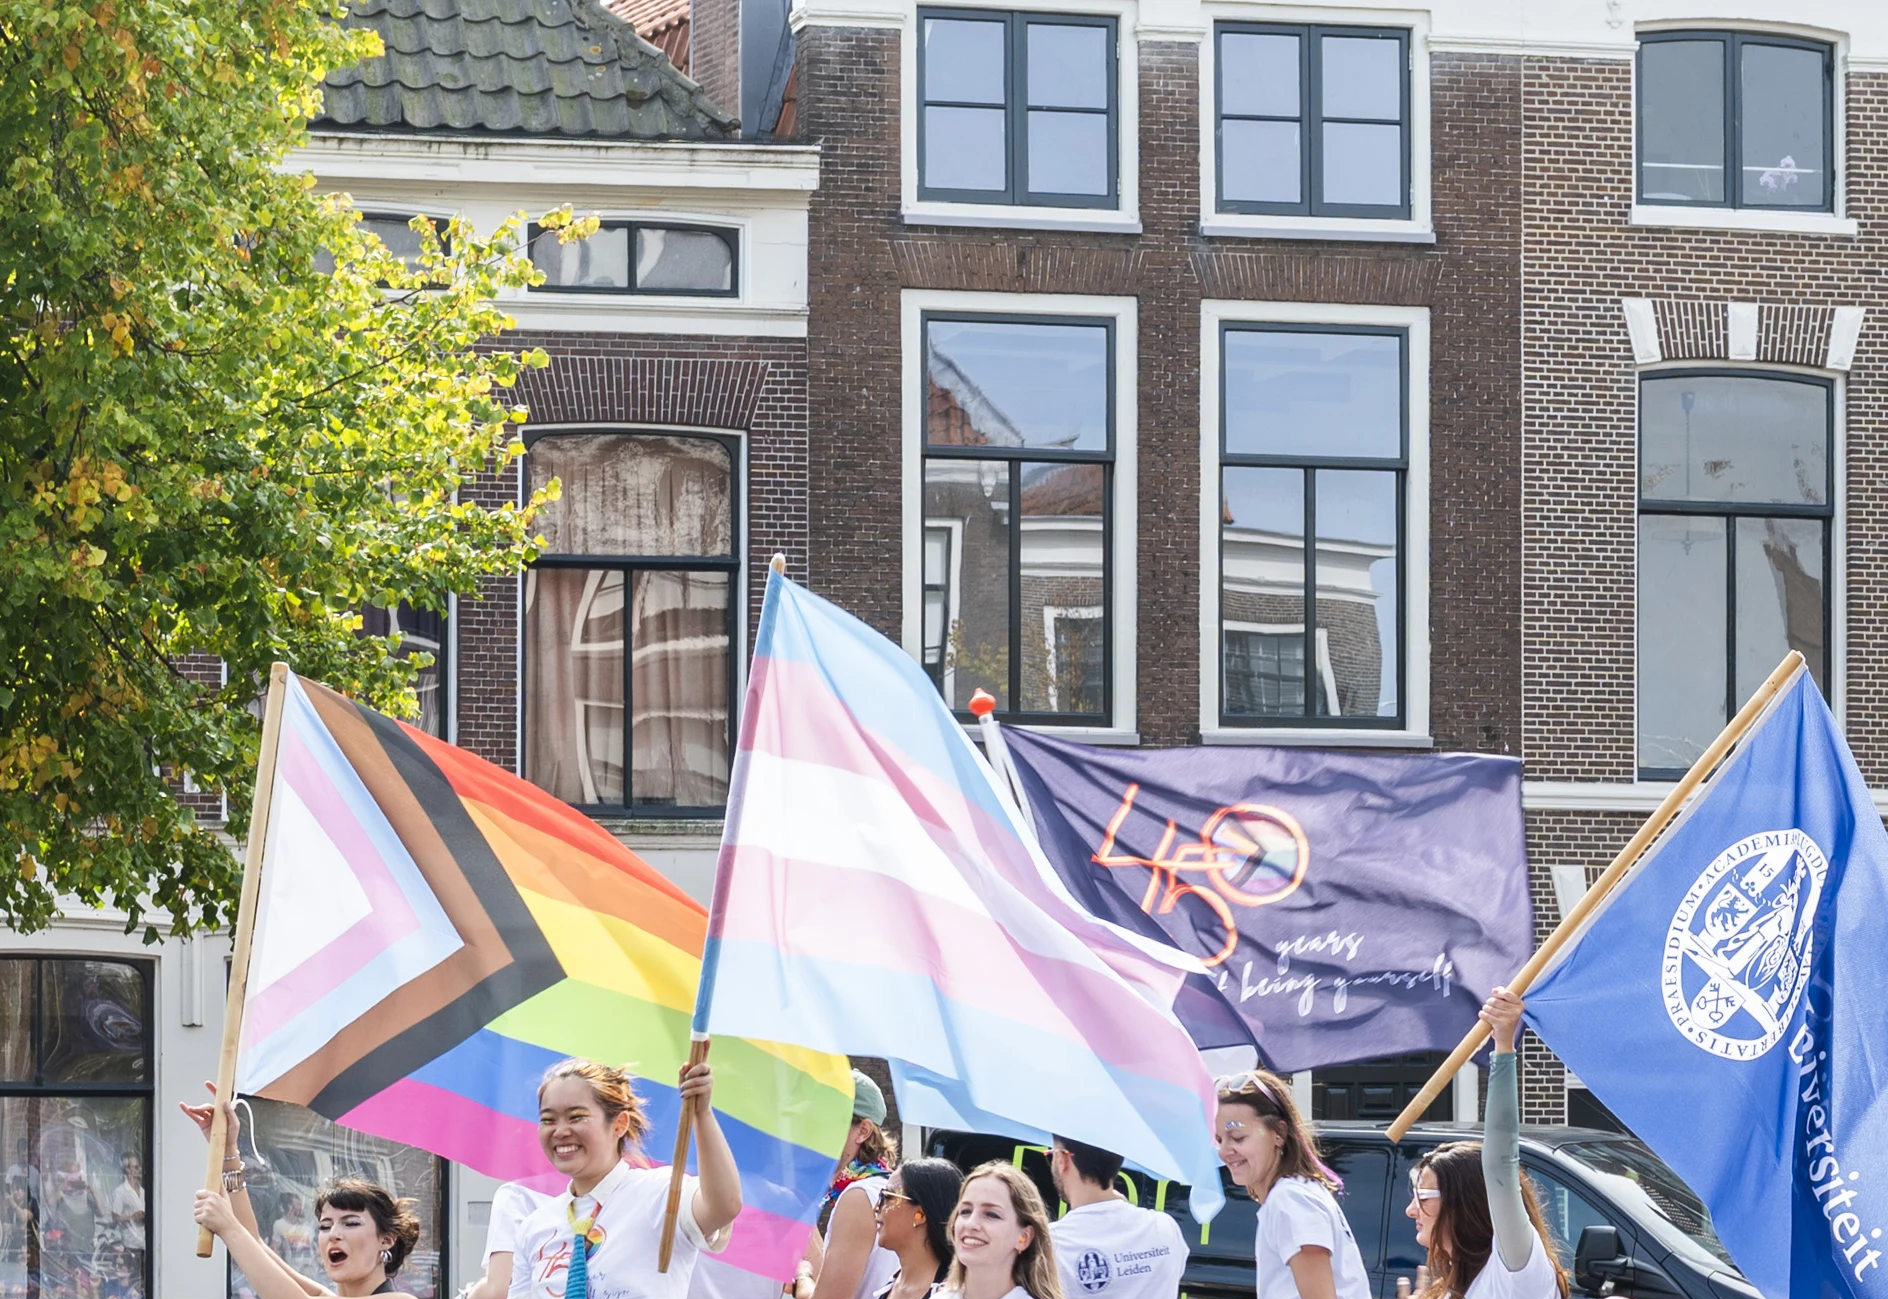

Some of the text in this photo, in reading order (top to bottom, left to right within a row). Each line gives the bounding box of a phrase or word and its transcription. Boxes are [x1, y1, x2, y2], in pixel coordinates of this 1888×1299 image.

[1275, 930, 1365, 976] years
[1240, 960, 1322, 1017] being
[1113, 1245, 1171, 1263] Universiteit
[1116, 1264, 1152, 1277] Leiden
